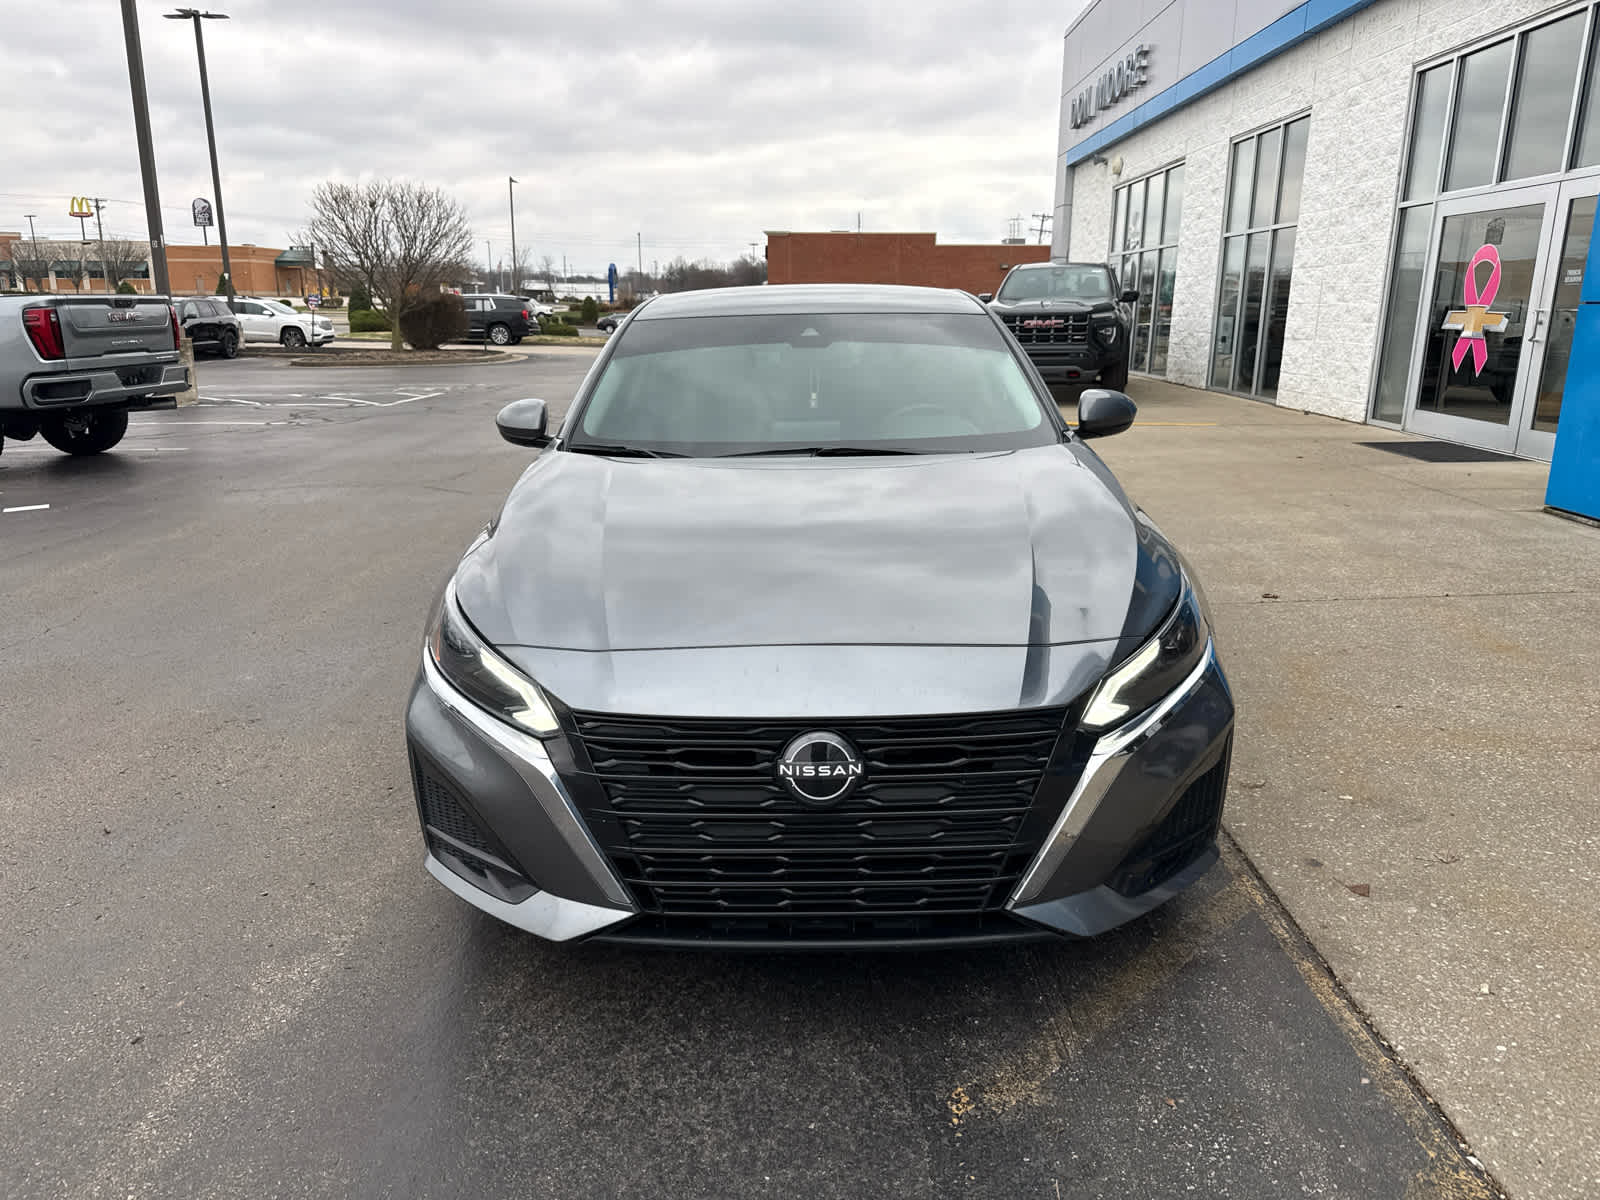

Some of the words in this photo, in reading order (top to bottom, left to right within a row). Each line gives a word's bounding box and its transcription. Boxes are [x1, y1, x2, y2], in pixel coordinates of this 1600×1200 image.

[1096, 44, 1149, 111] MOORE
[1024, 319, 1065, 329] GMC
[780, 763, 862, 777] NISSAN
